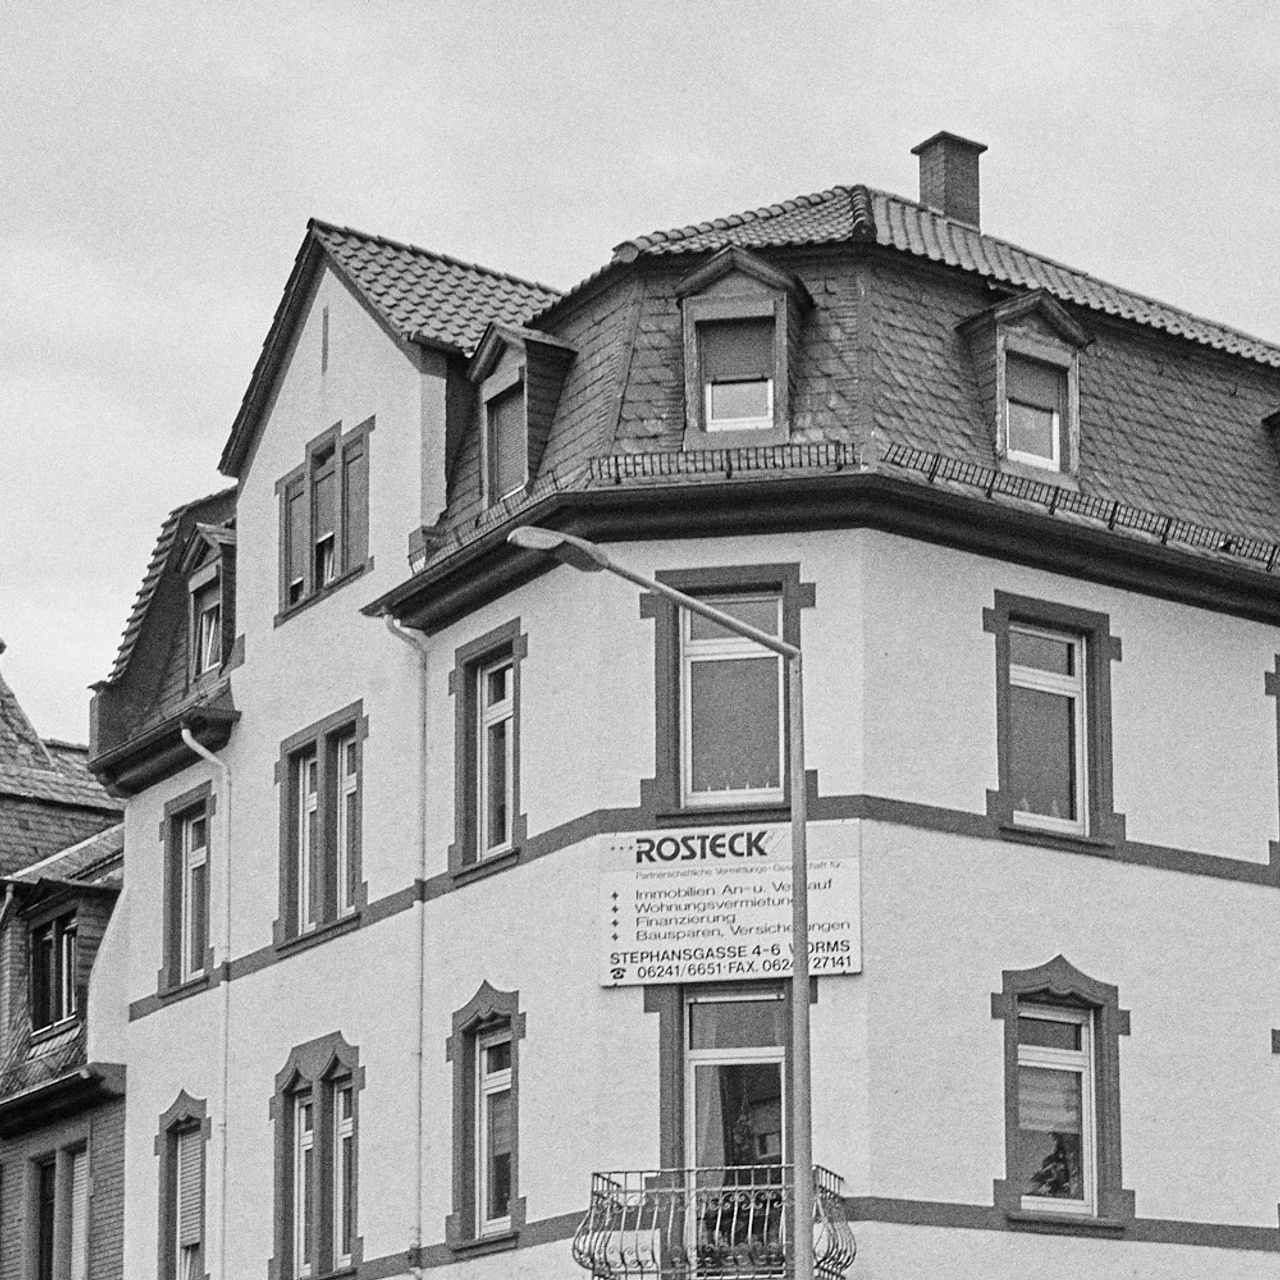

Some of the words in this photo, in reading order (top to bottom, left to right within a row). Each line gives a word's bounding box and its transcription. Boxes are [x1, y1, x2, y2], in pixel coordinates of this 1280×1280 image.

[636, 831, 768, 864] ROSTECK
[636, 887, 716, 900] Immobilien
[772, 878, 833, 893] Veauf
[635, 896, 794, 914] Wohnungsvermietun
[636, 913, 736, 928] Finanzierung
[636, 928, 724, 941] Bausparen,
[610, 945, 748, 965] STEPHANSGASSE
[752, 943, 781, 957] 4-6
